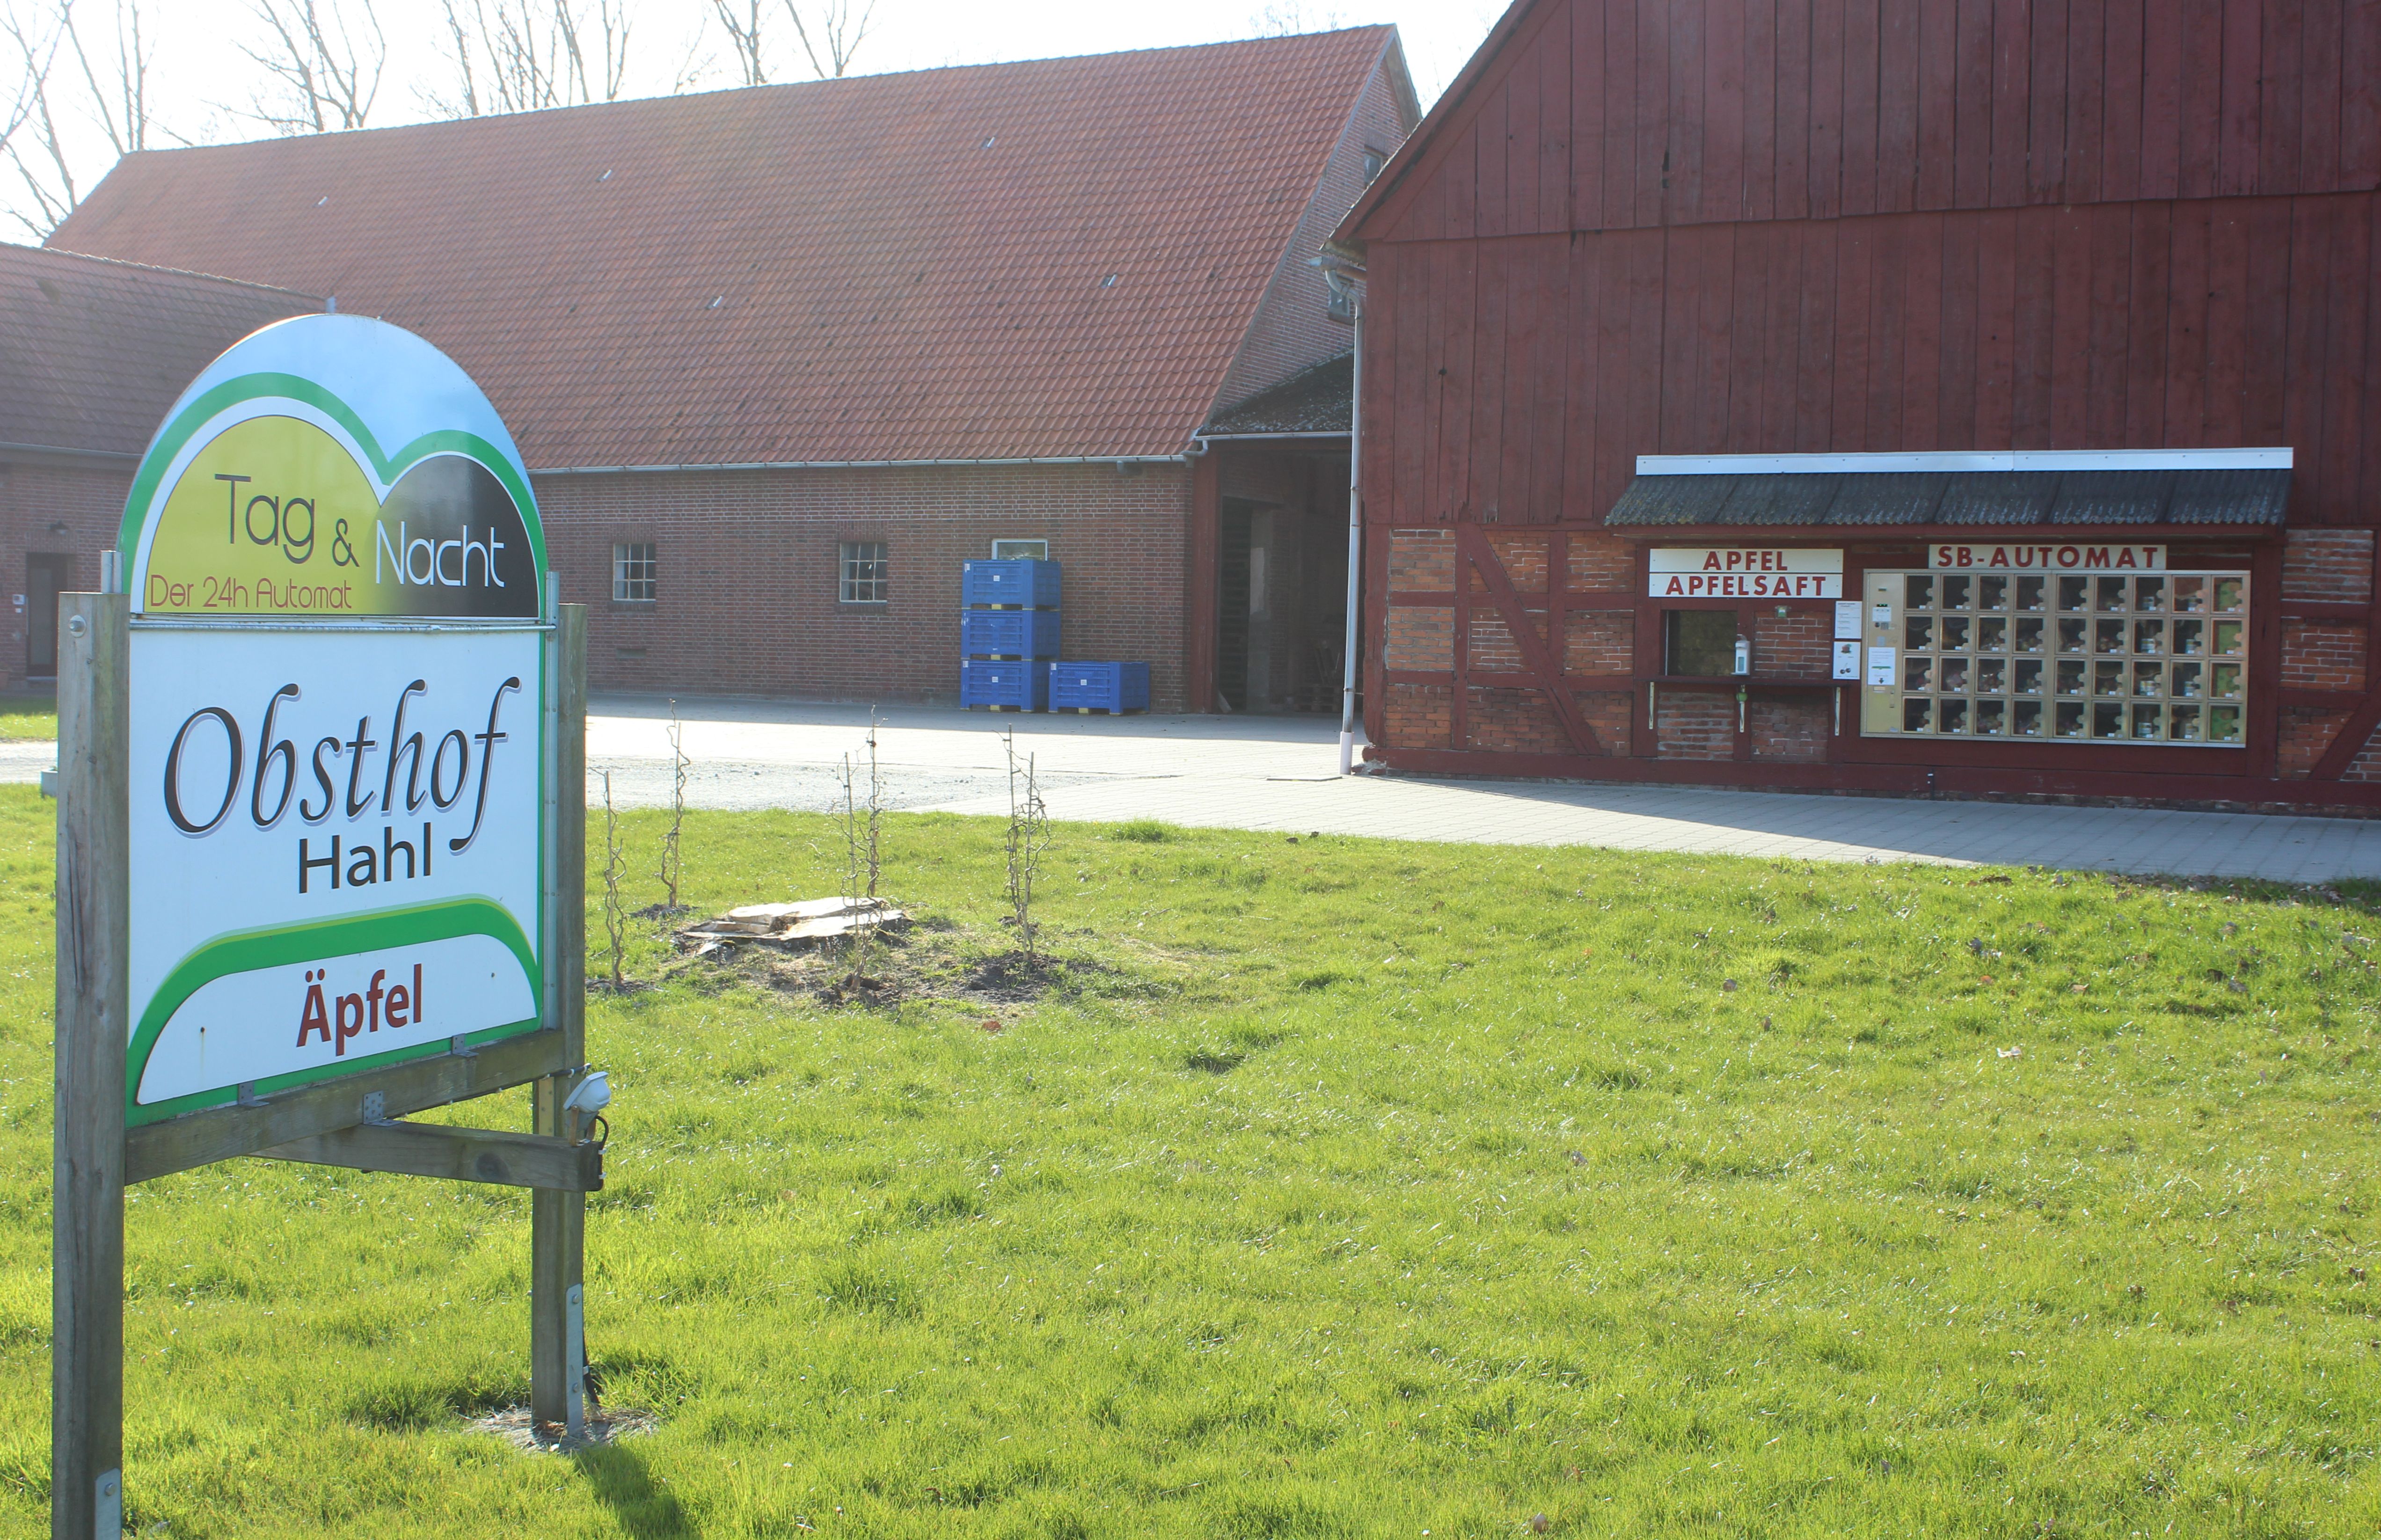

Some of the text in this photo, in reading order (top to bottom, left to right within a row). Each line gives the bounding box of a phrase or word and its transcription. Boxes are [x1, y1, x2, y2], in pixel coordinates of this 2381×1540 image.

[215, 473, 504, 588] Tag & Nacht
[1938, 545, 2158, 568] SB-AUTOMAT
[150, 574, 352, 609] Der 24h Automat
[1665, 576, 1826, 597] APFELSAFT
[163, 676, 522, 853] Obsthof
[298, 822, 431, 894] Hahl
[296, 963, 422, 1056] Äpfel
